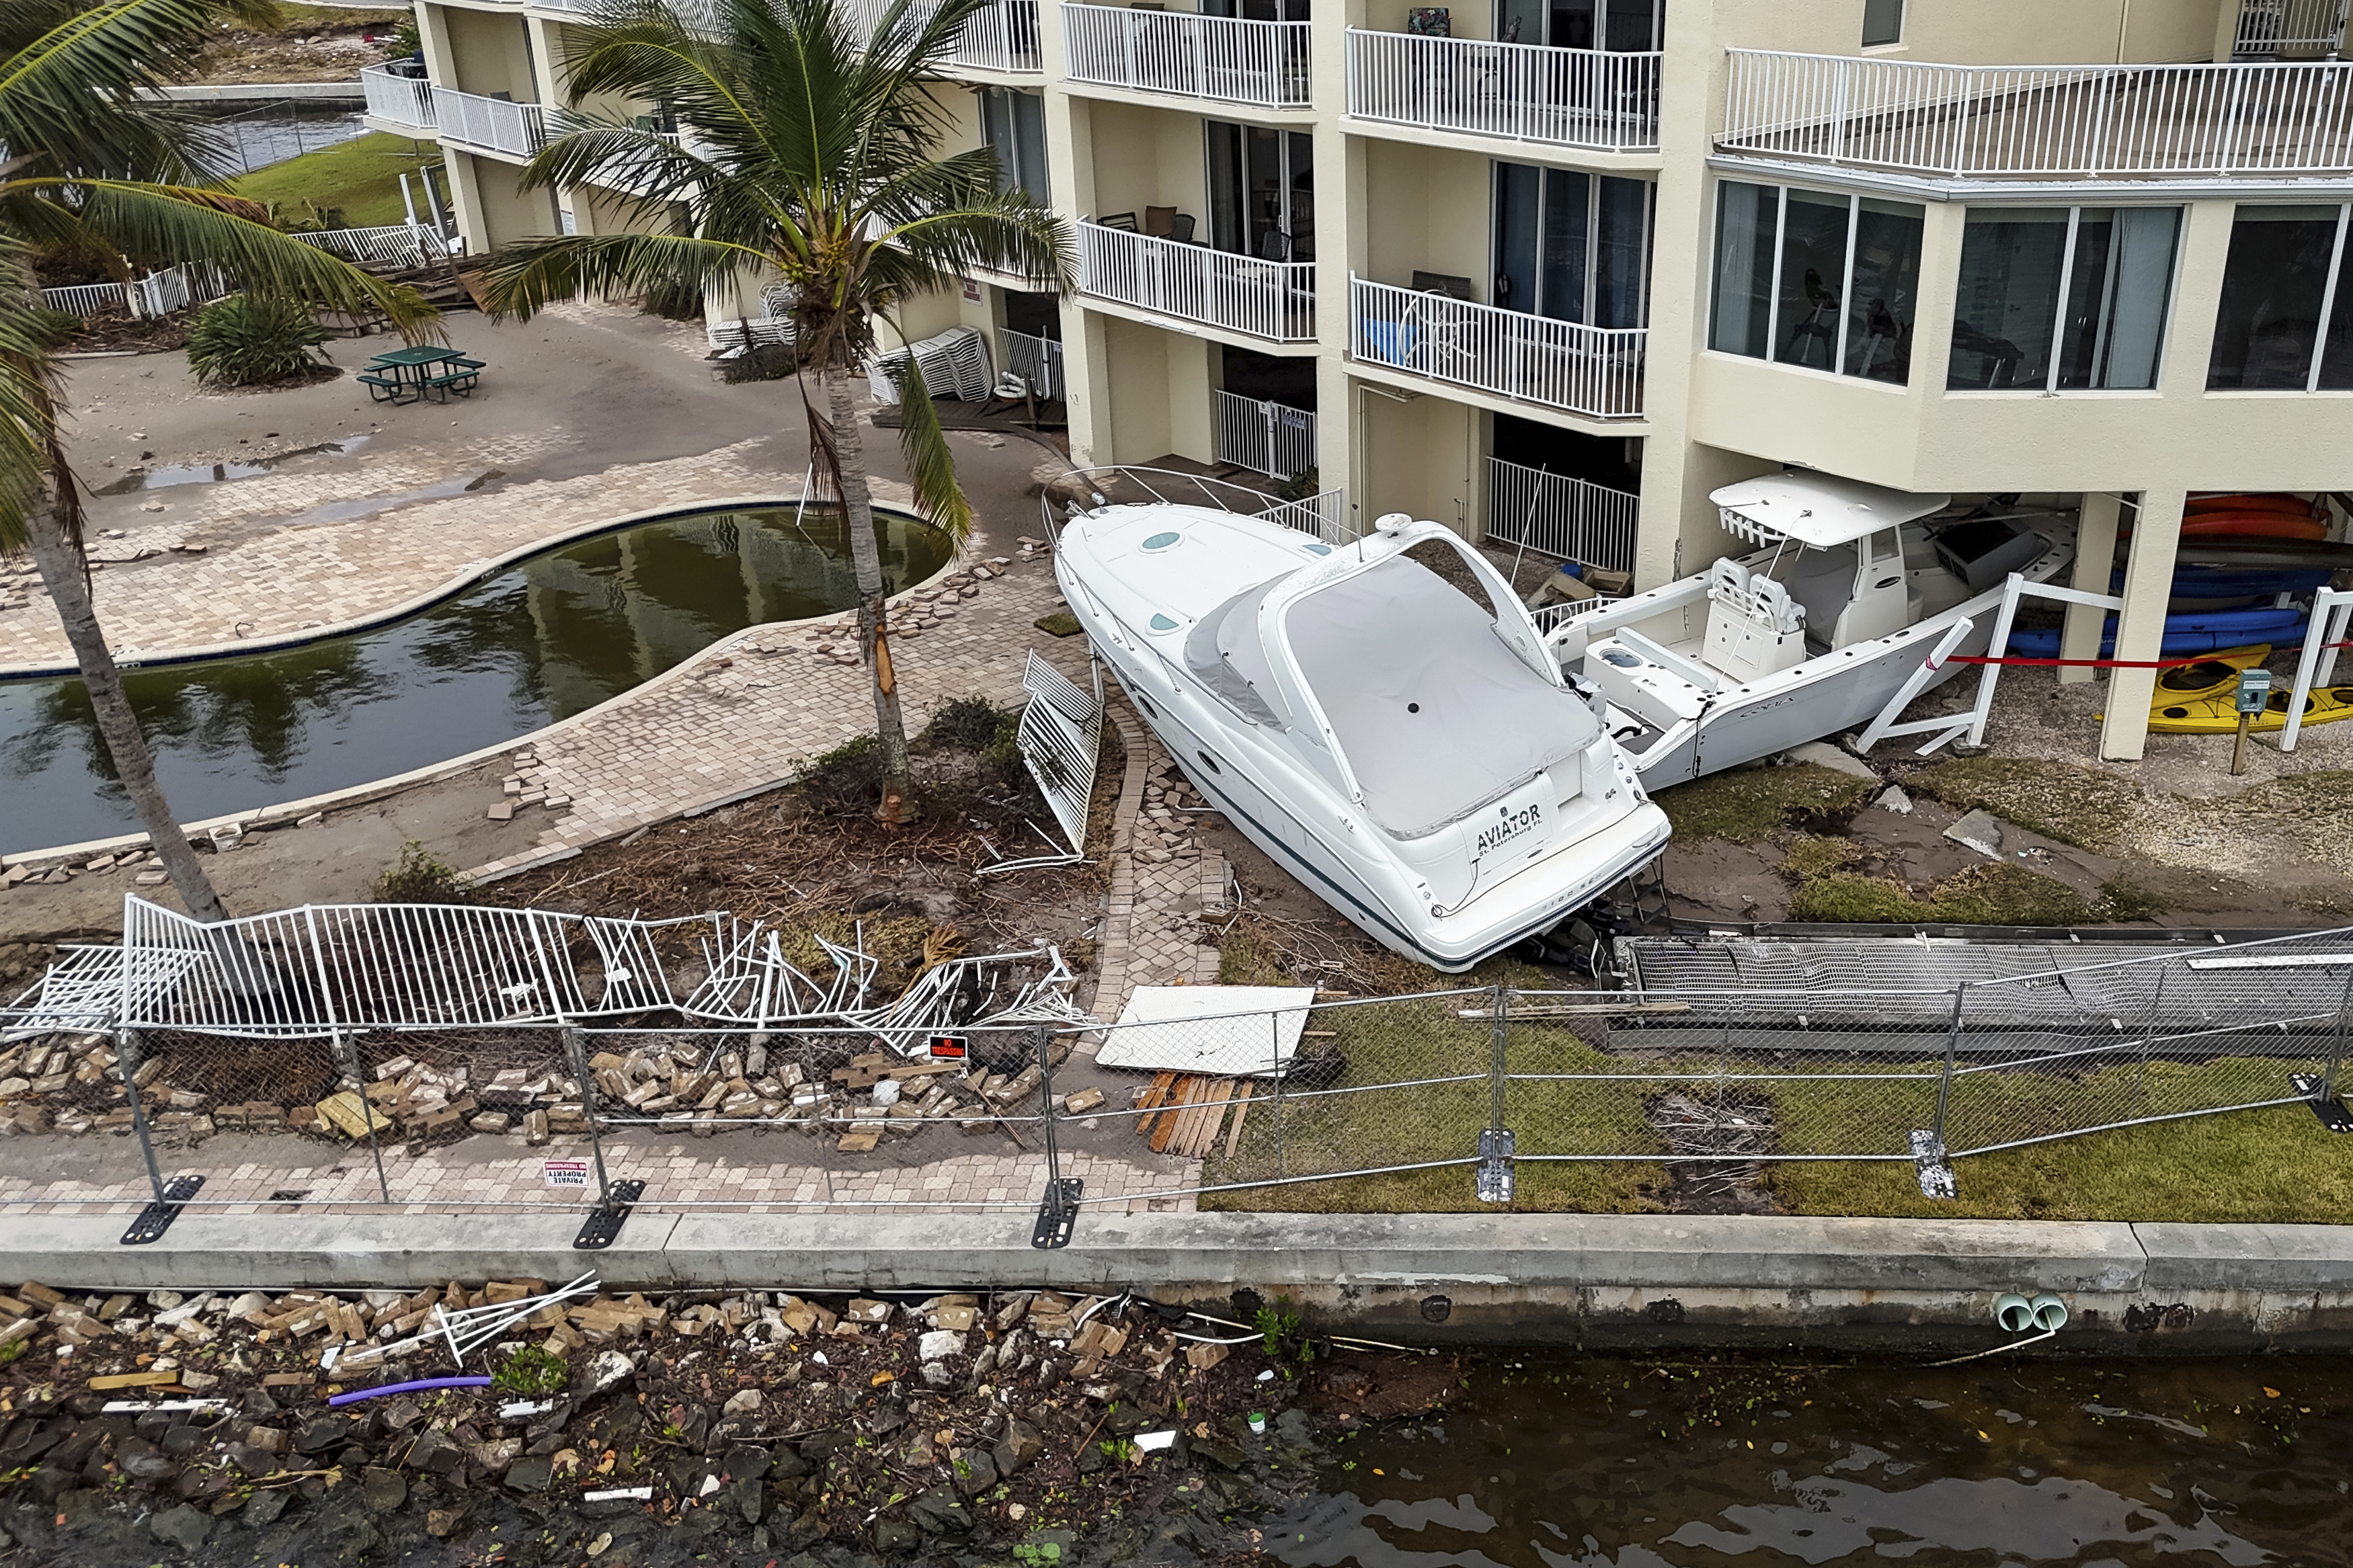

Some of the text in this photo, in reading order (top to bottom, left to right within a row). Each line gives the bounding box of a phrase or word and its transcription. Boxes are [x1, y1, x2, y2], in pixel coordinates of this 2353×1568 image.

[1478, 804, 1540, 850] AVIATOR
[944, 1039, 952, 1047] NO
[932, 1046, 965, 1056] TRESPASSING
